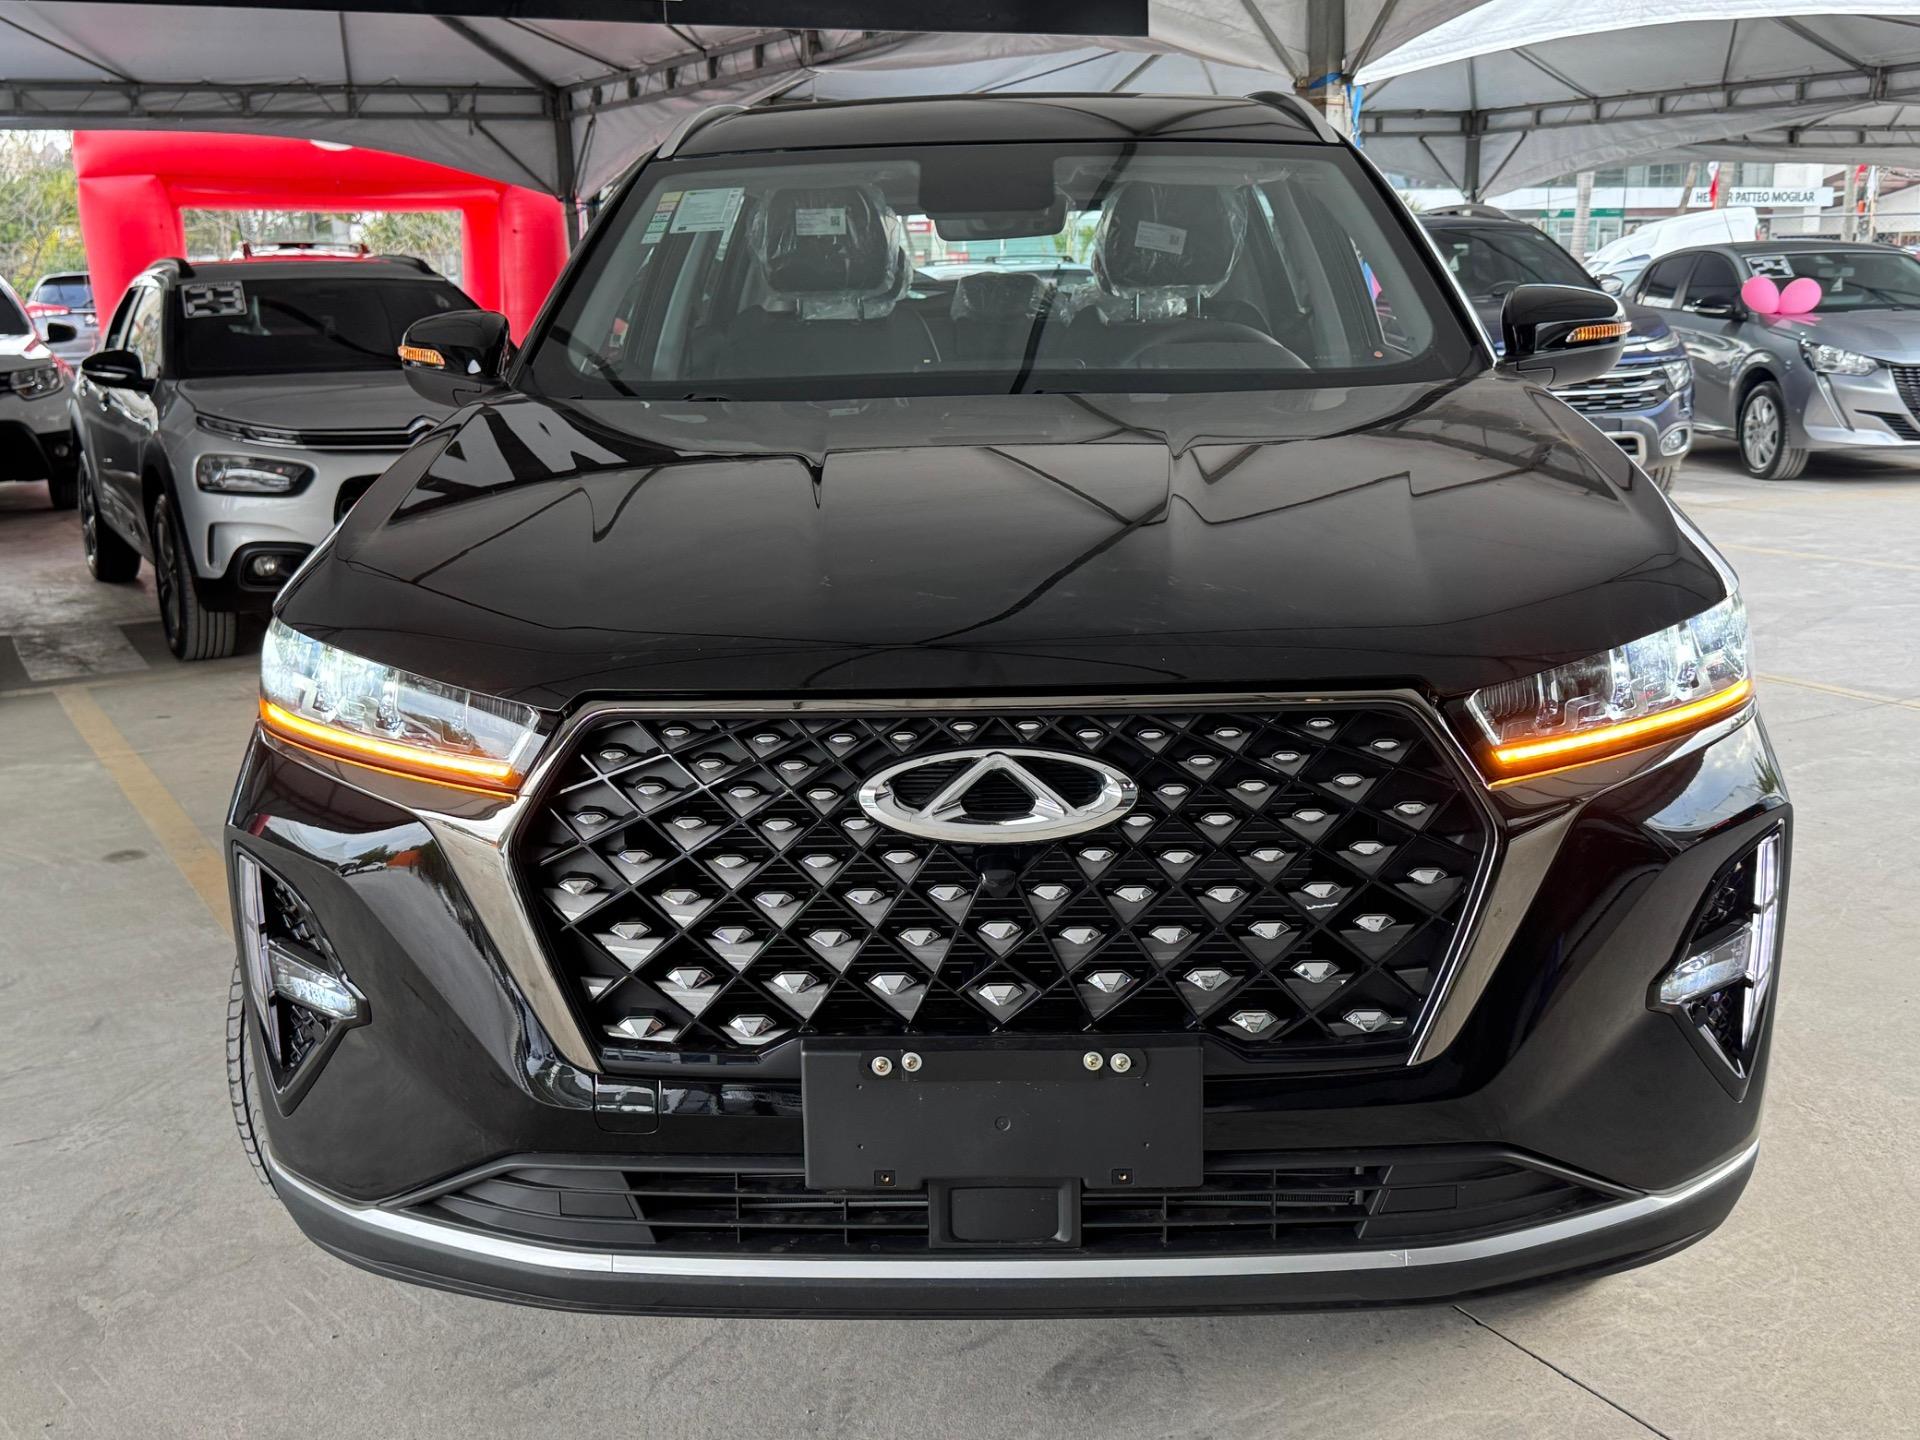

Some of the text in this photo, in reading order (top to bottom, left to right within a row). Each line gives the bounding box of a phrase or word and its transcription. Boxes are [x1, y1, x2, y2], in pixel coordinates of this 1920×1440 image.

[1736, 191, 1770, 203] PATTEO
[1772, 191, 1816, 203] MOGILAR
[187, 286, 244, 316] 23
